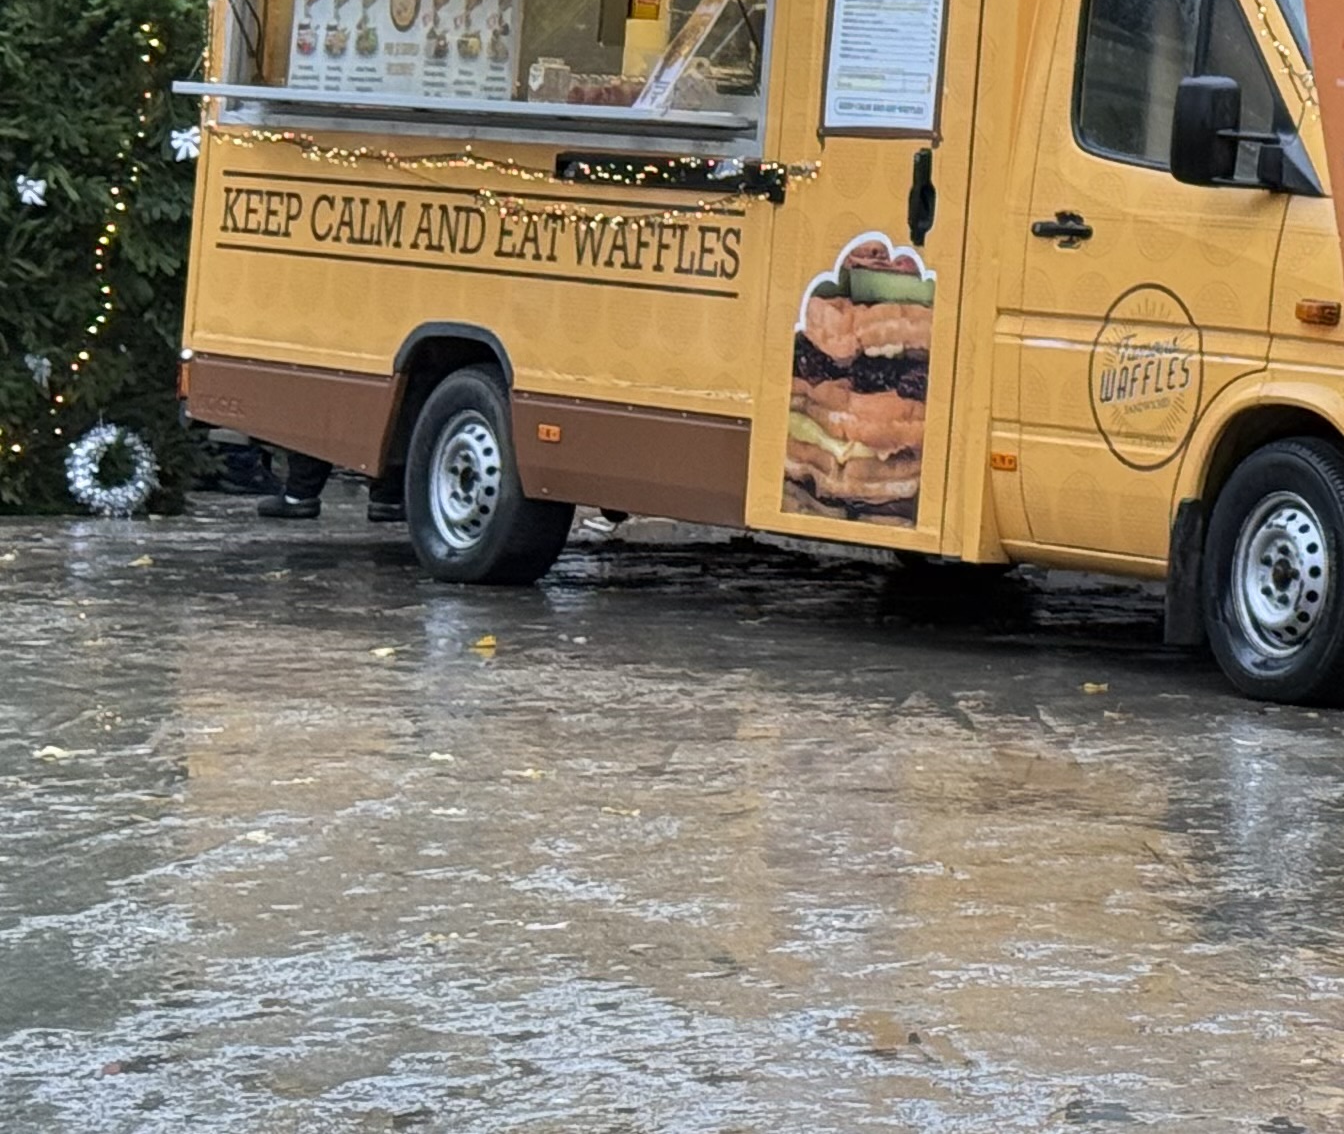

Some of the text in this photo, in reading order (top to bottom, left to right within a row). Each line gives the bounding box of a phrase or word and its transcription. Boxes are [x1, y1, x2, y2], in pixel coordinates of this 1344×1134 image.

[219, 186, 742, 281] KEEP CALM AND EAT WAFFLES
[1099, 355, 1191, 403] WAFFLES
